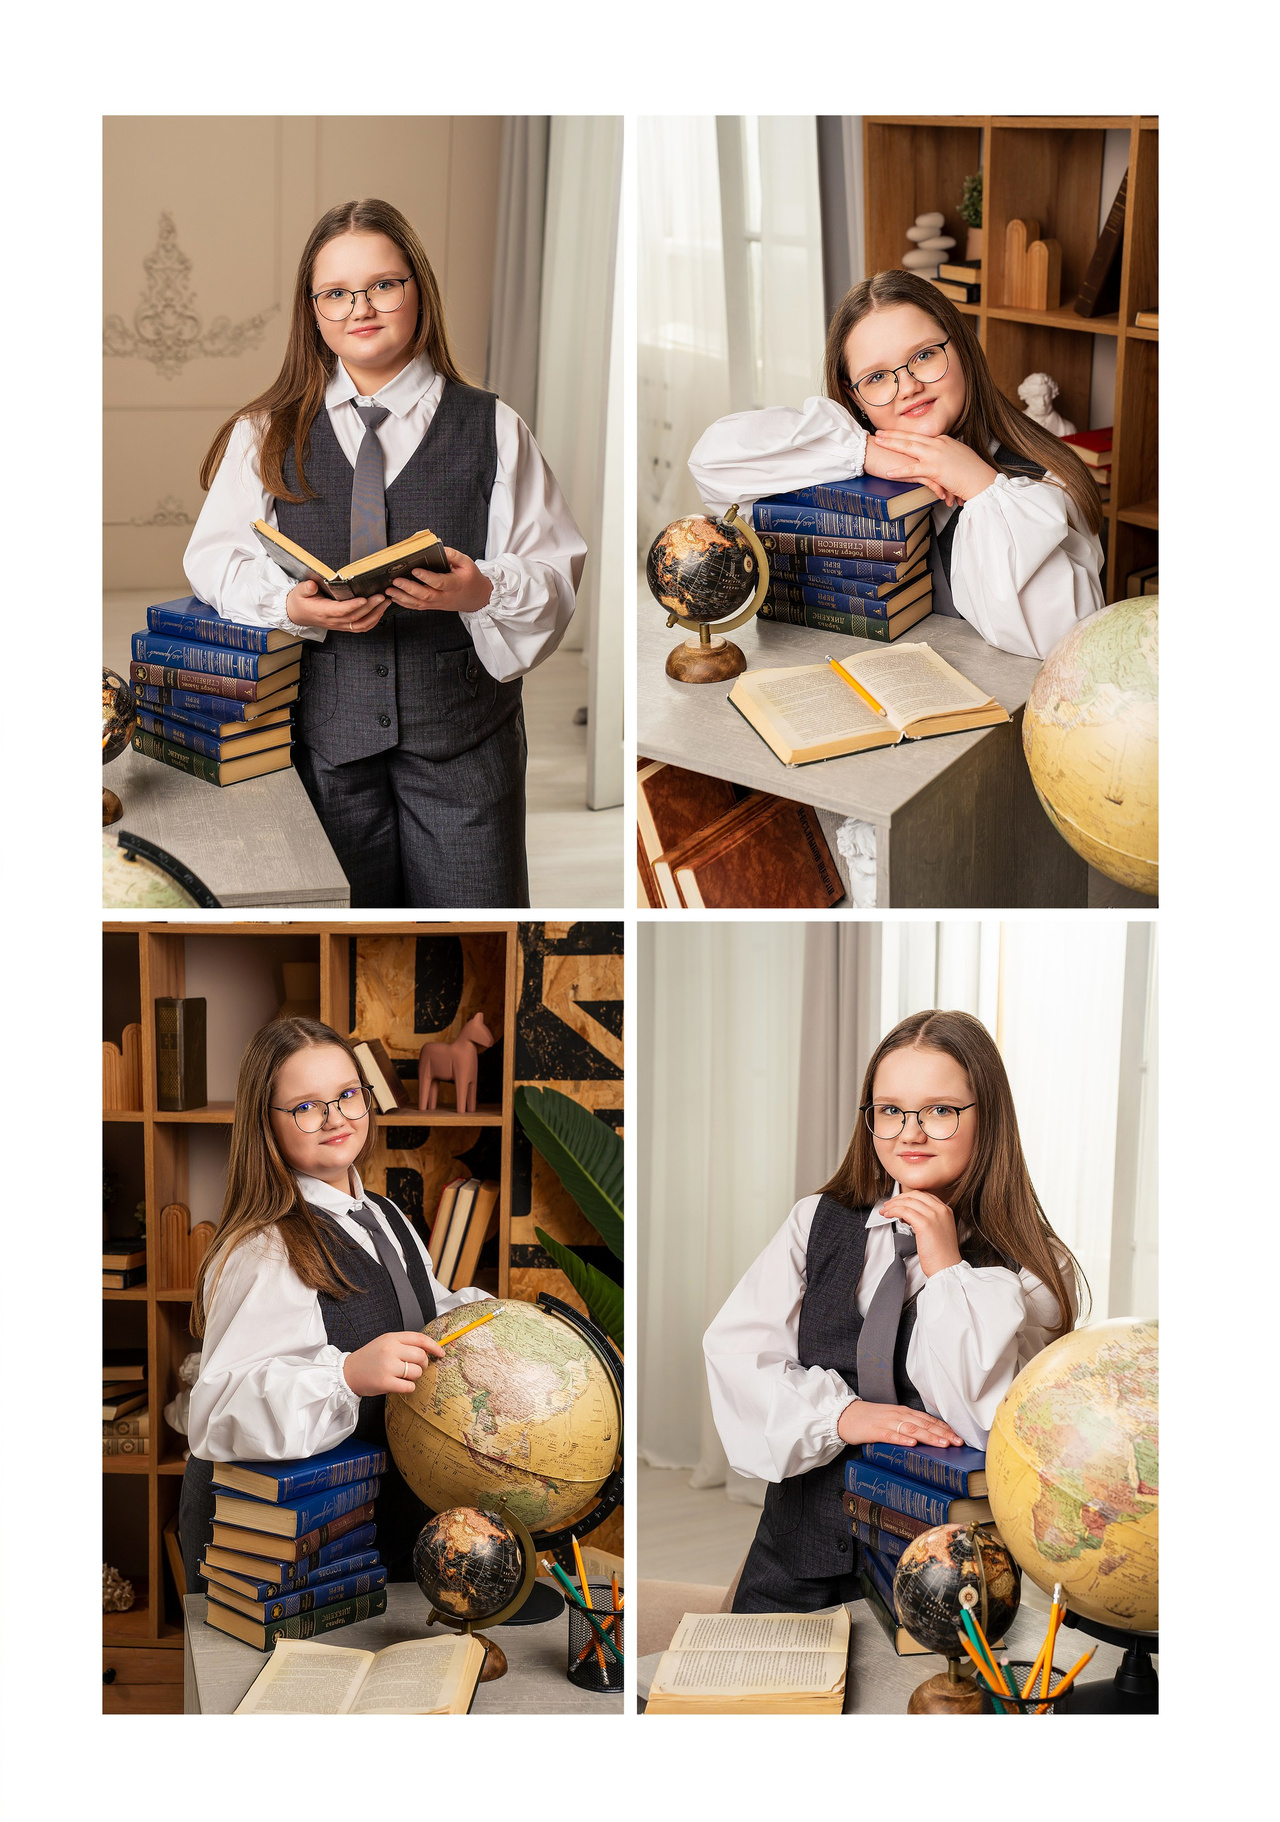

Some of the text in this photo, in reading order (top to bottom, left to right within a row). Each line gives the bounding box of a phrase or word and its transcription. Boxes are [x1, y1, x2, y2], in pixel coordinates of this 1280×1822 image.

[817, 540, 863, 550] СТИВЕНСОН
[841, 549, 863, 557] Роберт
[823, 561, 841, 569] ВЕРН
[807, 575, 832, 586] ГОГОЛЬ
[817, 593, 835, 603] ВЕРН
[812, 612, 845, 624] ДИККЕНС
[817, 622, 840, 630] Чарльз
[181, 674, 220, 687] СТИВЕНСОН
[318, 1565, 342, 1578] ГОГОЛЬ
[328, 1584, 345, 1595] ВЕРН
[321, 1607, 351, 1622] ДИККЕНС
[325, 1618, 347, 1628] Чарльз
